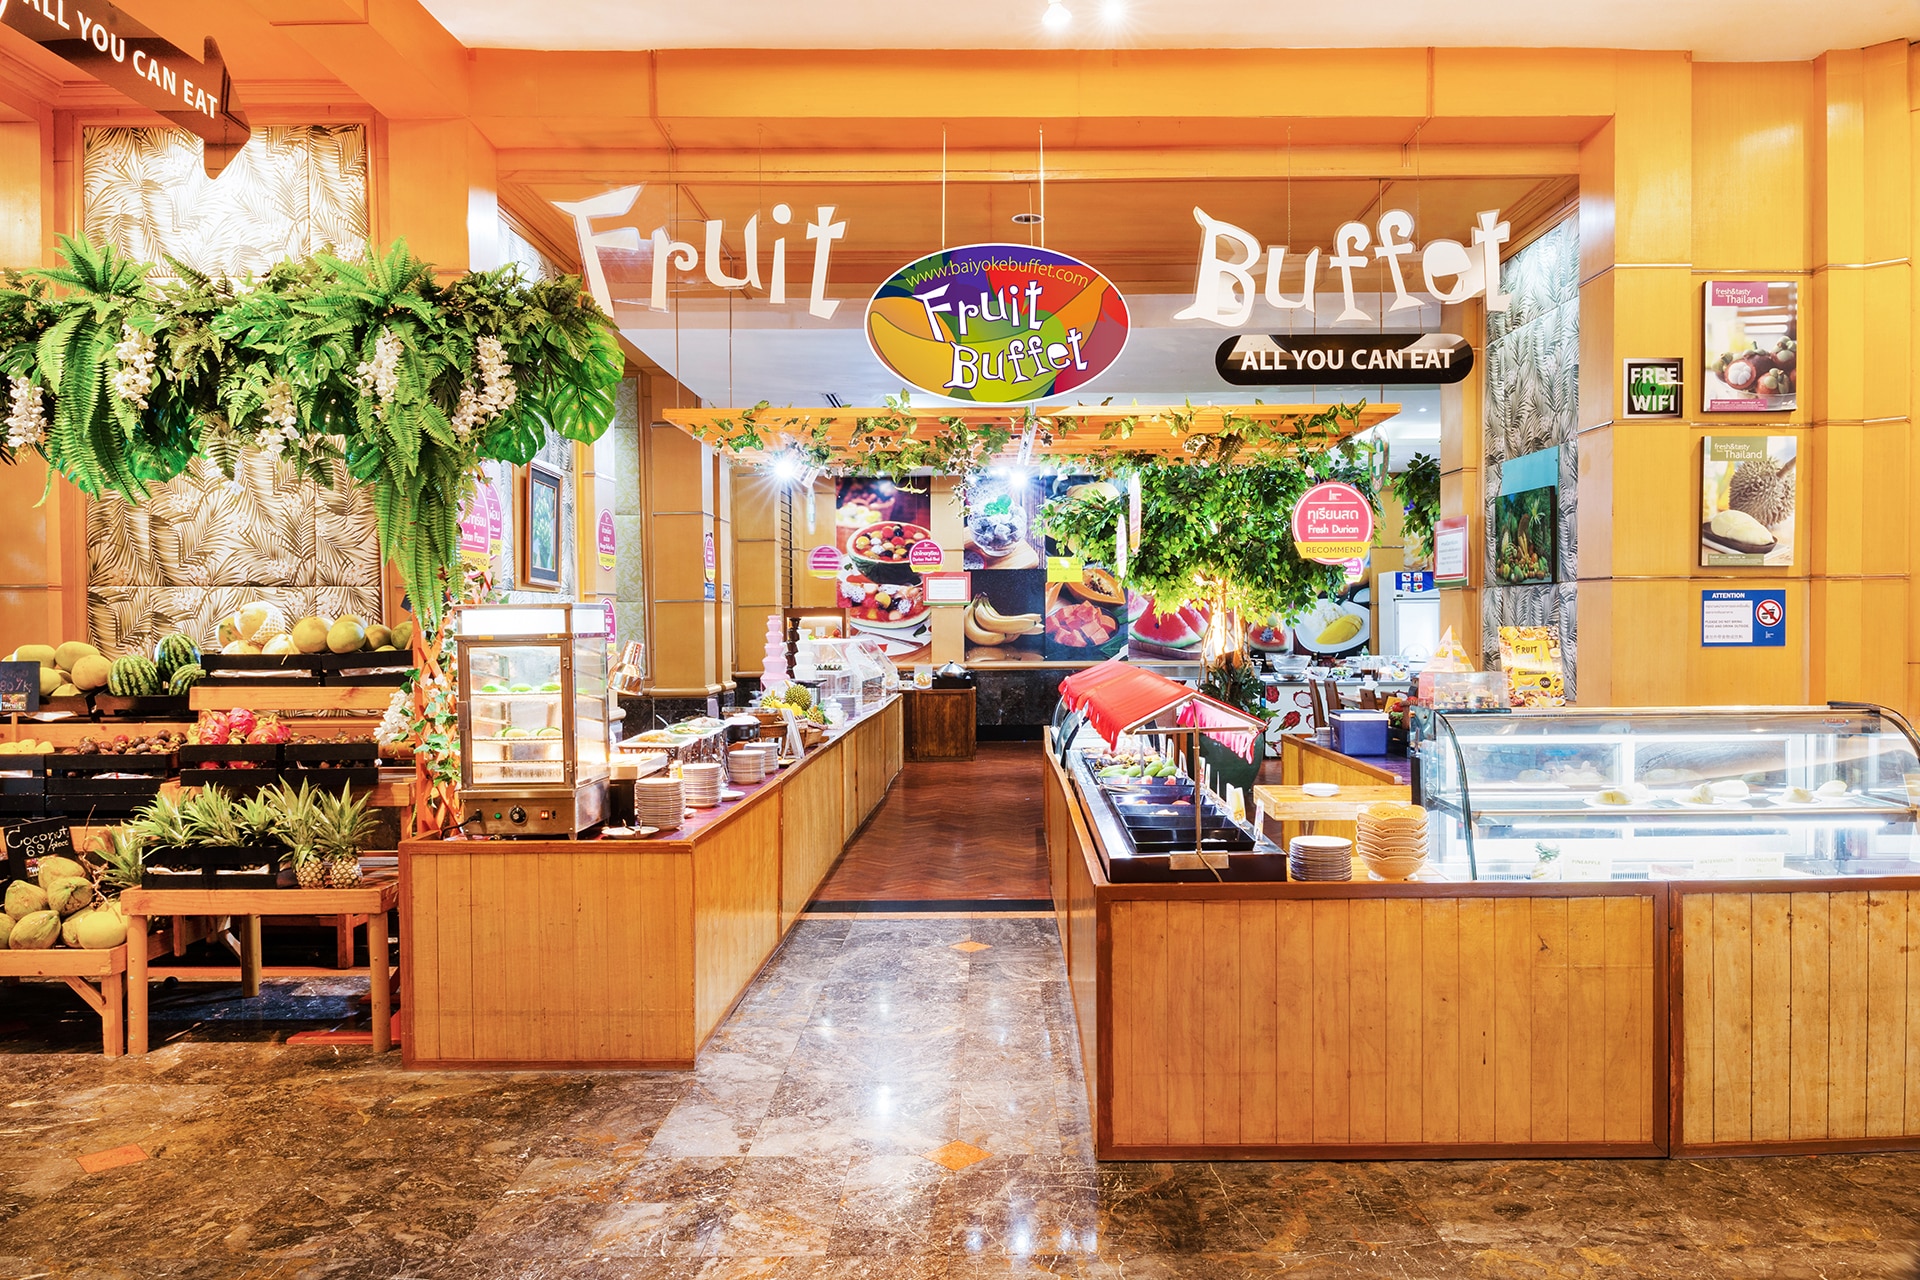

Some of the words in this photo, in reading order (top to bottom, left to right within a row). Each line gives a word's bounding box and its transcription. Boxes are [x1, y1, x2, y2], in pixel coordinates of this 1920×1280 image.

[77, 10, 125, 63] YOU
[132, 50, 177, 96] CAN
[183, 79, 218, 119] EAT
[550, 184, 847, 321] Fruit
[1173, 206, 1512, 328] Buffet
[905, 255, 1090, 288] www.baiyokebuffet.com
[1726, 294, 1764, 304] Thailand
[911, 279, 1045, 343] Fruit
[943, 327, 1089, 391] Buffet
[1240, 349, 1288, 372] ALL
[1290, 349, 1344, 371] YOU
[1351, 348, 1404, 370] CAN
[1410, 348, 1456, 370] EAT
[1630, 367, 1678, 385] FREE
[1631, 394, 1676, 412] WIFI
[1725, 449, 1763, 459] Thailand
[1307, 507, 1359, 524] ทุเรียนสด
[1307, 524, 1329, 534] Fresh
[1331, 524, 1359, 534] Durian
[1305, 546, 1363, 554] RECOMMEND
[1515, 644, 1538, 654] FRUIT
[6, 825, 68, 849] Coconut
